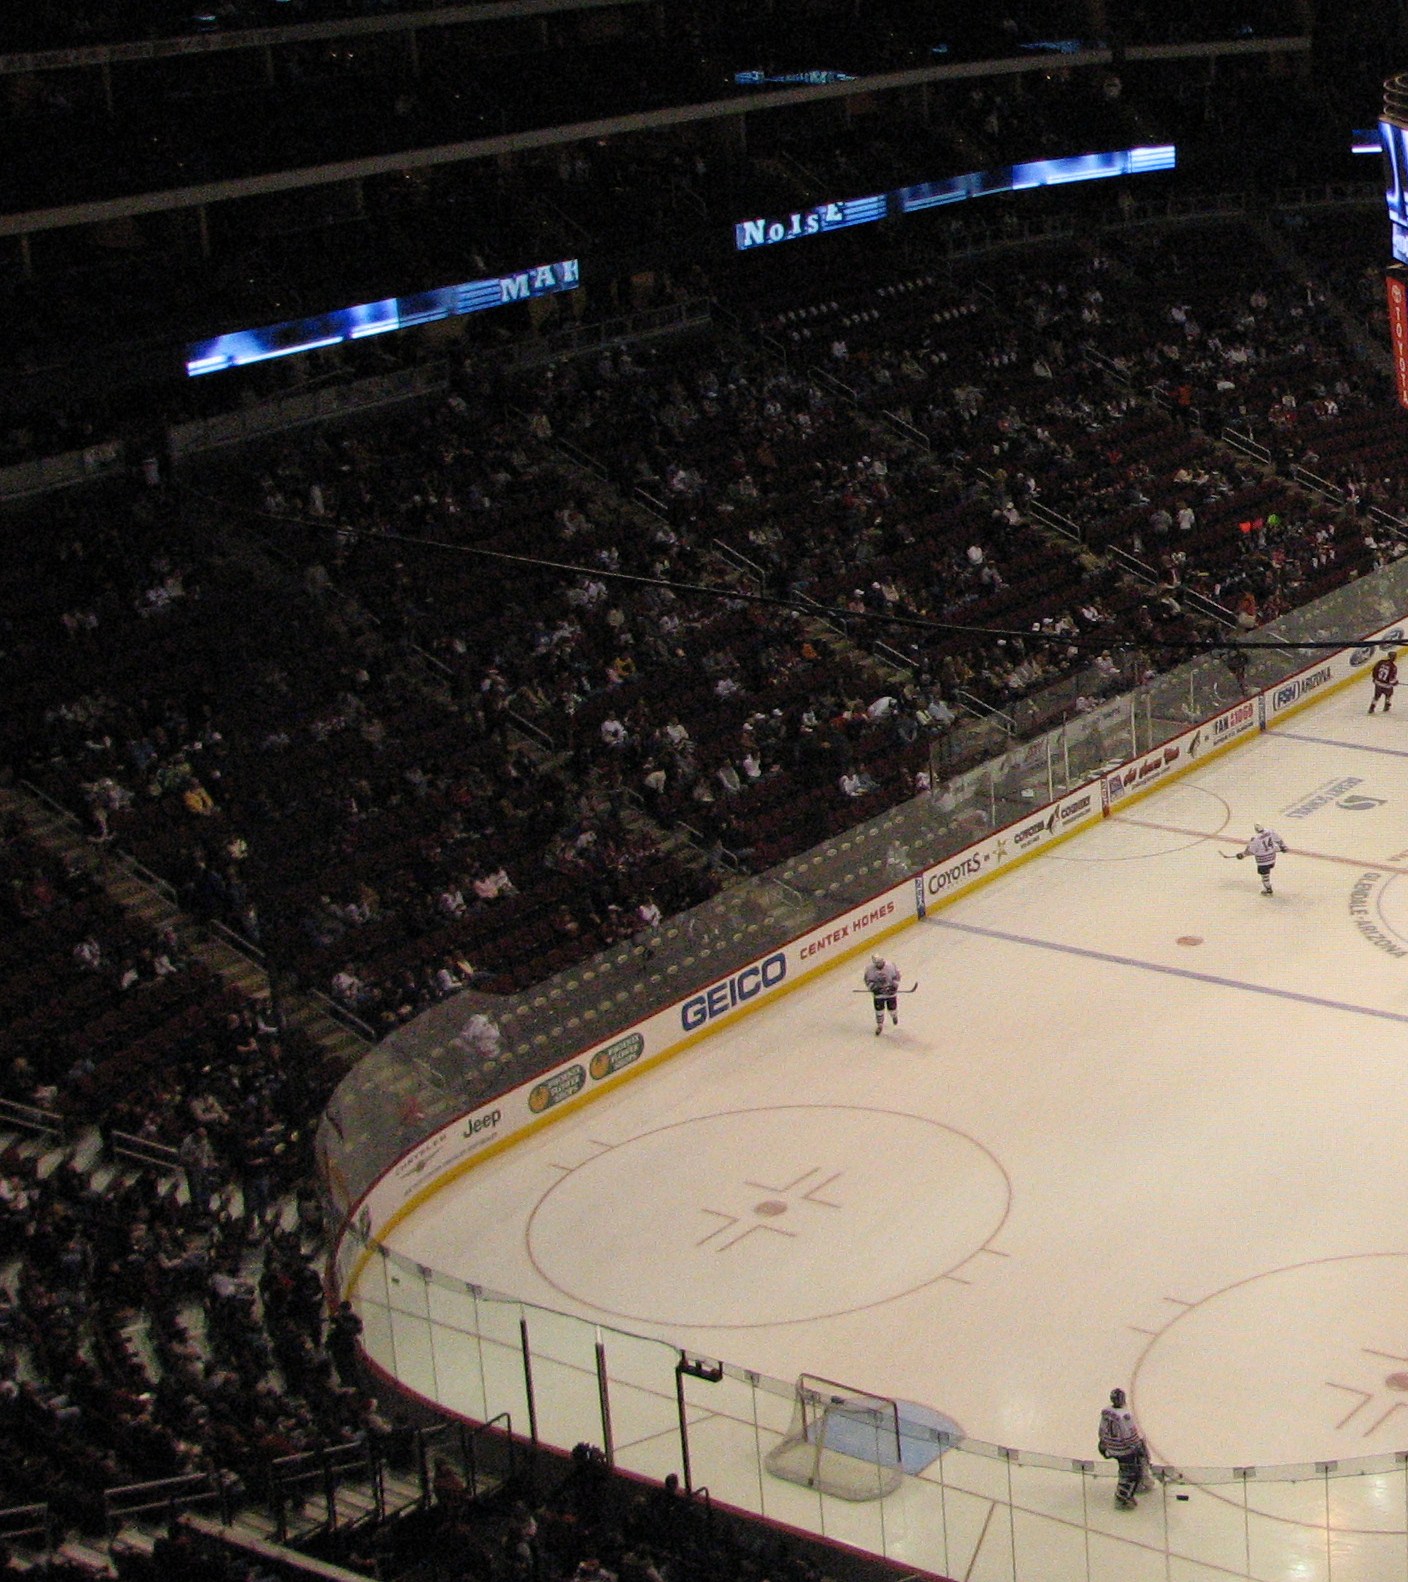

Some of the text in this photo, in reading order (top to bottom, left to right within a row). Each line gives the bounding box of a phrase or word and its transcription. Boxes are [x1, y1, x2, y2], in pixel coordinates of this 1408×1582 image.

[1396, 307, 1408, 405] TOYOTA
[928, 852, 981, 895] COYOTES
[800, 901, 895, 960] CENTEX HOMES
[681, 952, 787, 1031] GEICO
[463, 1109, 502, 1138] Jeep
